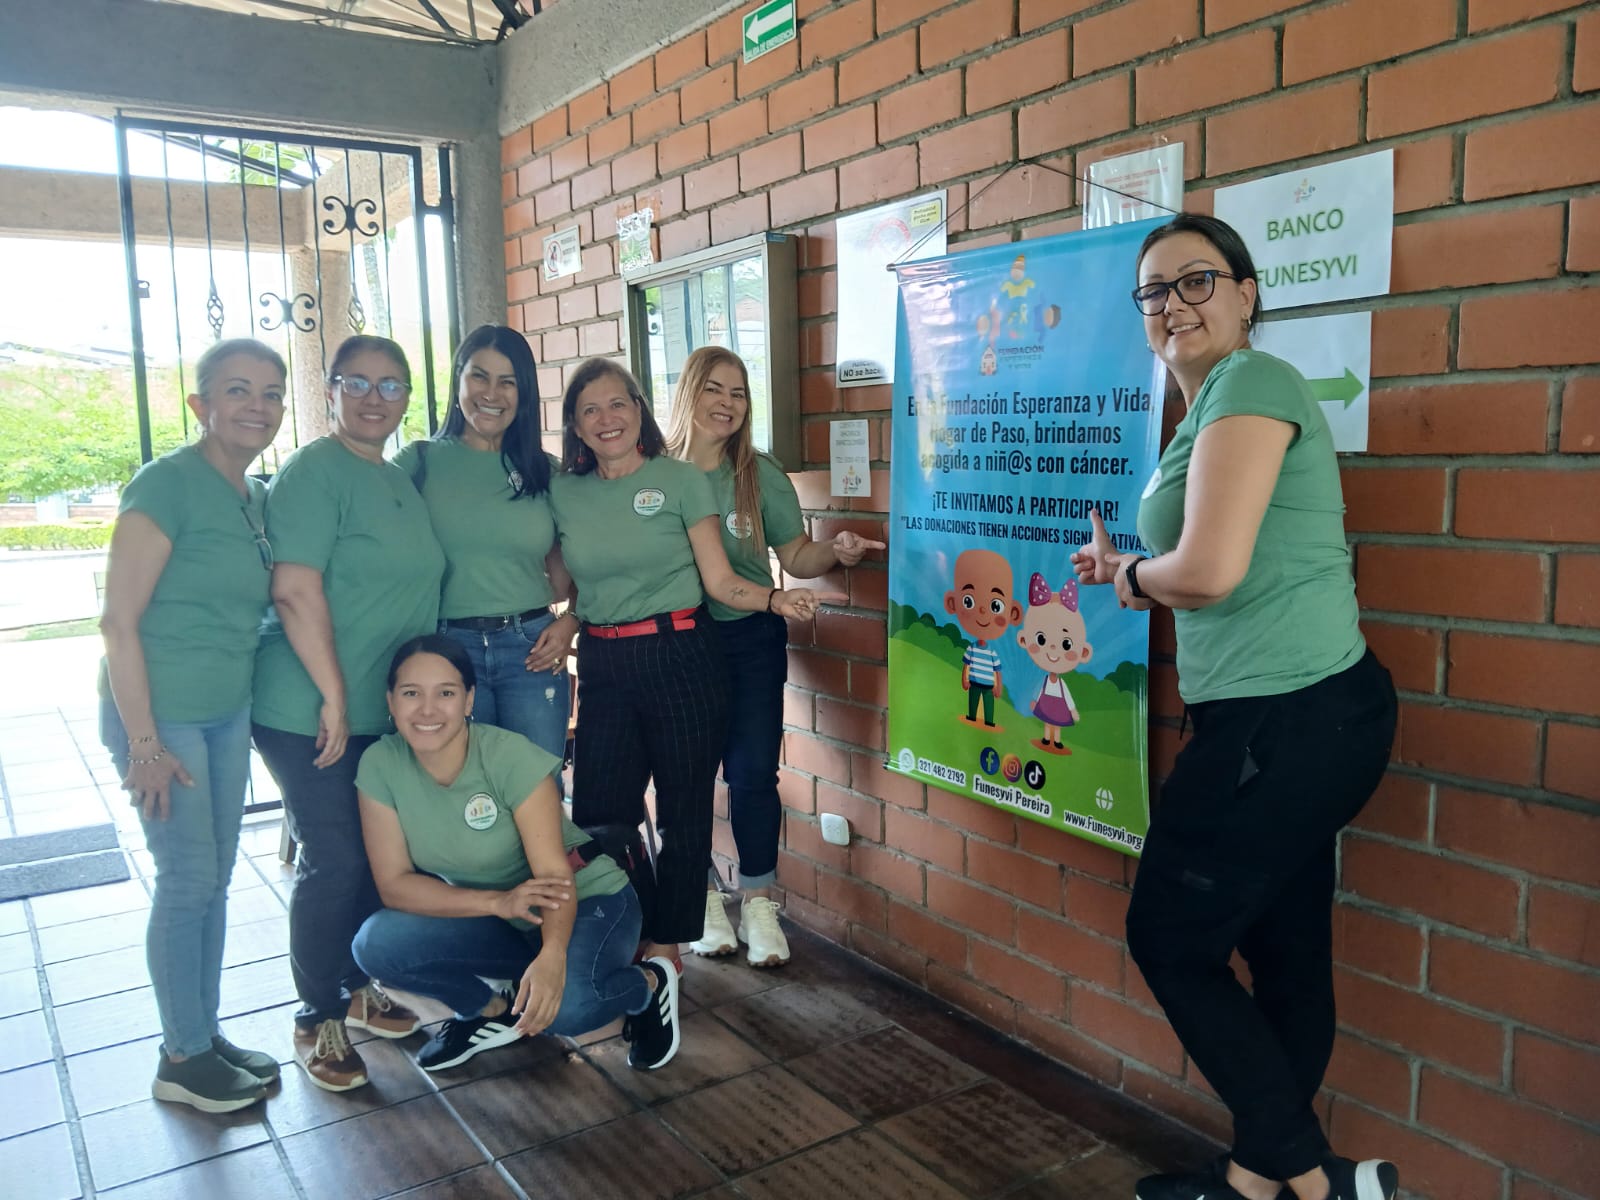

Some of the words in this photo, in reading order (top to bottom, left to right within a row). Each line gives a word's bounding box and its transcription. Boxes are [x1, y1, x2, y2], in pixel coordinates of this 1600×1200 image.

[1266, 208, 1344, 241] BANCO
[843, 369, 854, 377] NO
[1013, 391, 1090, 419] Esperanza
[1096, 395, 1106, 416] y
[971, 421, 987, 443] de
[992, 421, 1030, 446] Paso,
[1035, 420, 1121, 444] brindamos
[921, 449, 969, 473] acogida
[973, 455, 981, 470] a
[985, 449, 1032, 475] niñ@s
[1037, 456, 1064, 473] con
[1070, 449, 1133, 475] cáncer.
[933, 491, 948, 511] ¡TE
[951, 492, 1013, 514] INVITAMOS
[1017, 496, 1026, 515] A
[1030, 496, 1119, 521] PARTICIPAR!
[924, 518, 976, 535] DONACIONES
[978, 522, 1008, 539] TIENEN
[1011, 525, 1060, 544] ACCIONES
[1063, 529, 1147, 551] SIGNIATIVA
[919, 759, 931, 771] 321
[933, 765, 946, 777] 482
[947, 769, 965, 785] 2792
[975, 777, 1013, 801] Funesyvi
[1015, 790, 1050, 815] Pereira
[1064, 811, 1143, 849] www.Funesyvi.org
